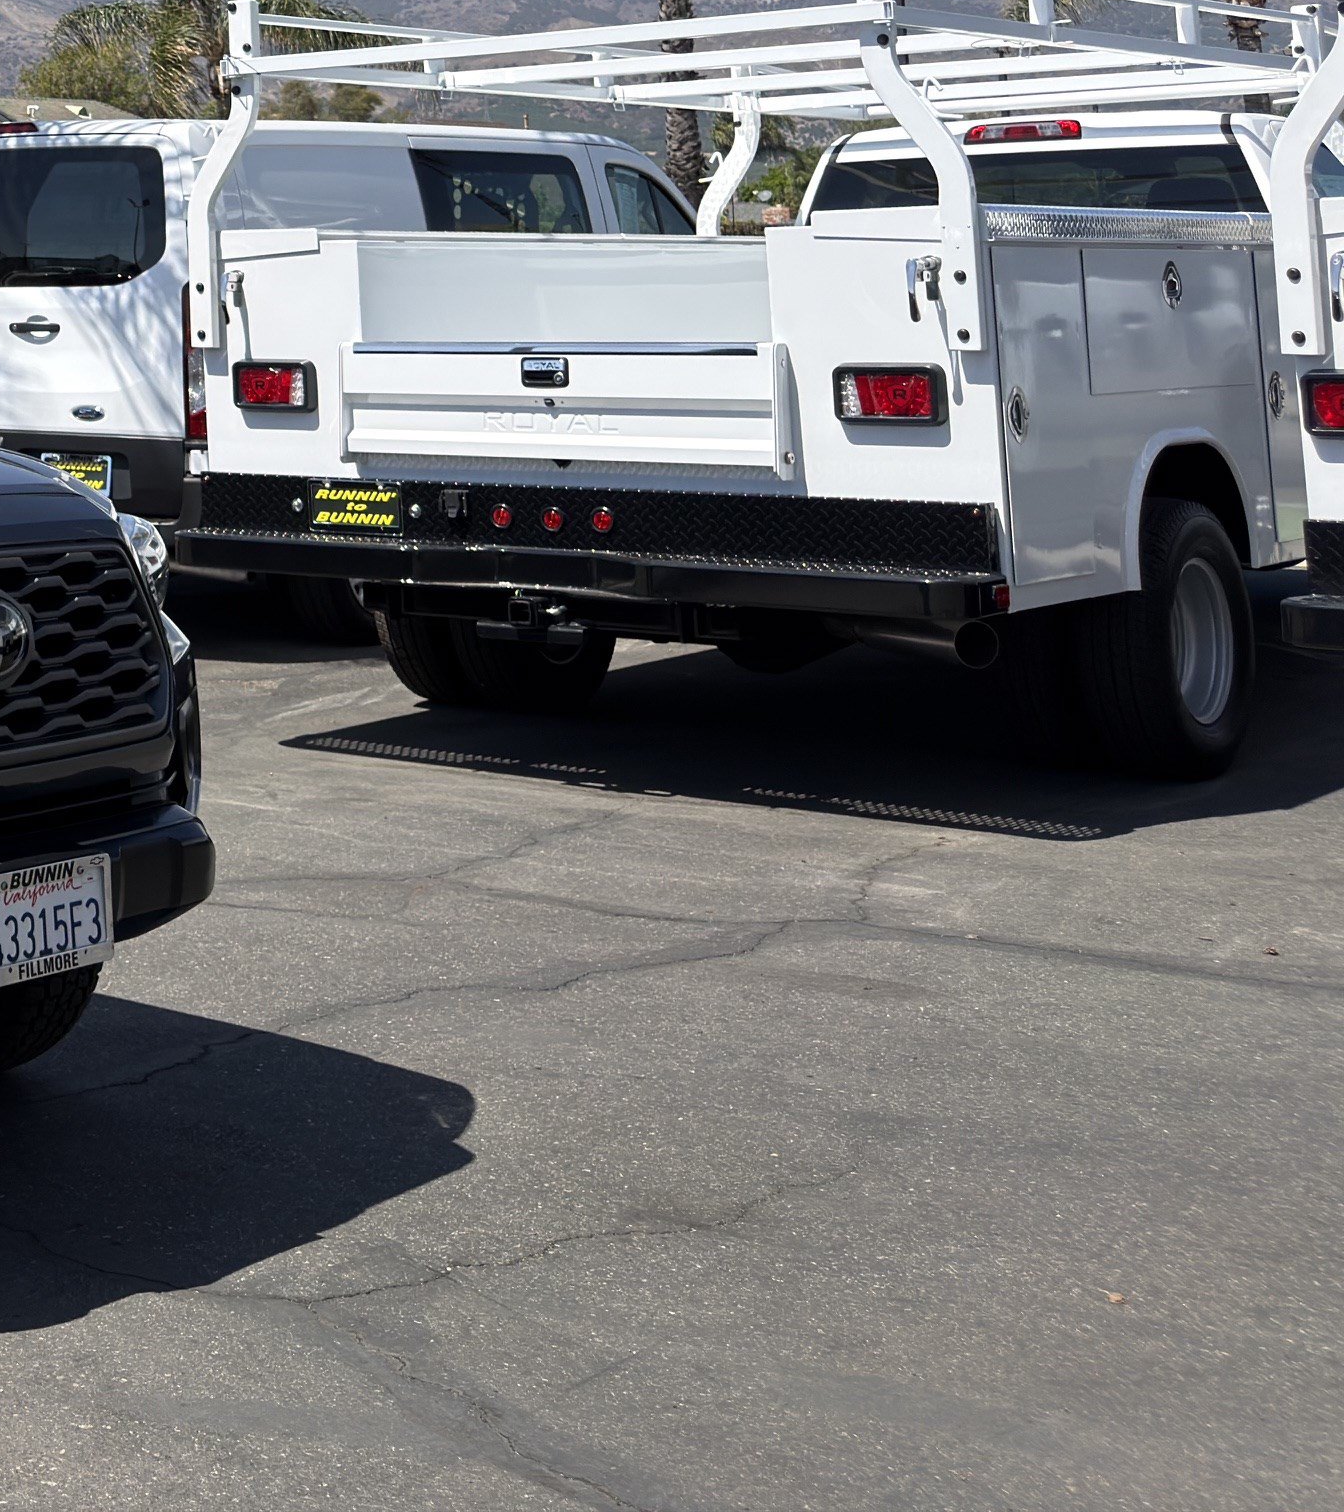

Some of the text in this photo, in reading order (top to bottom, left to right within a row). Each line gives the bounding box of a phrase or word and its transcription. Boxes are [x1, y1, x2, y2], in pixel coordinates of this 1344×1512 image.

[483, 412, 619, 434] ROYAL
[315, 489, 397, 502] RUNNIN'
[346, 502, 367, 511] to
[316, 511, 394, 525] BUNNIN
[11, 861, 74, 890] BUNNIN
[3, 877, 82, 908] California
[18, 951, 79, 980] FILLMORE
